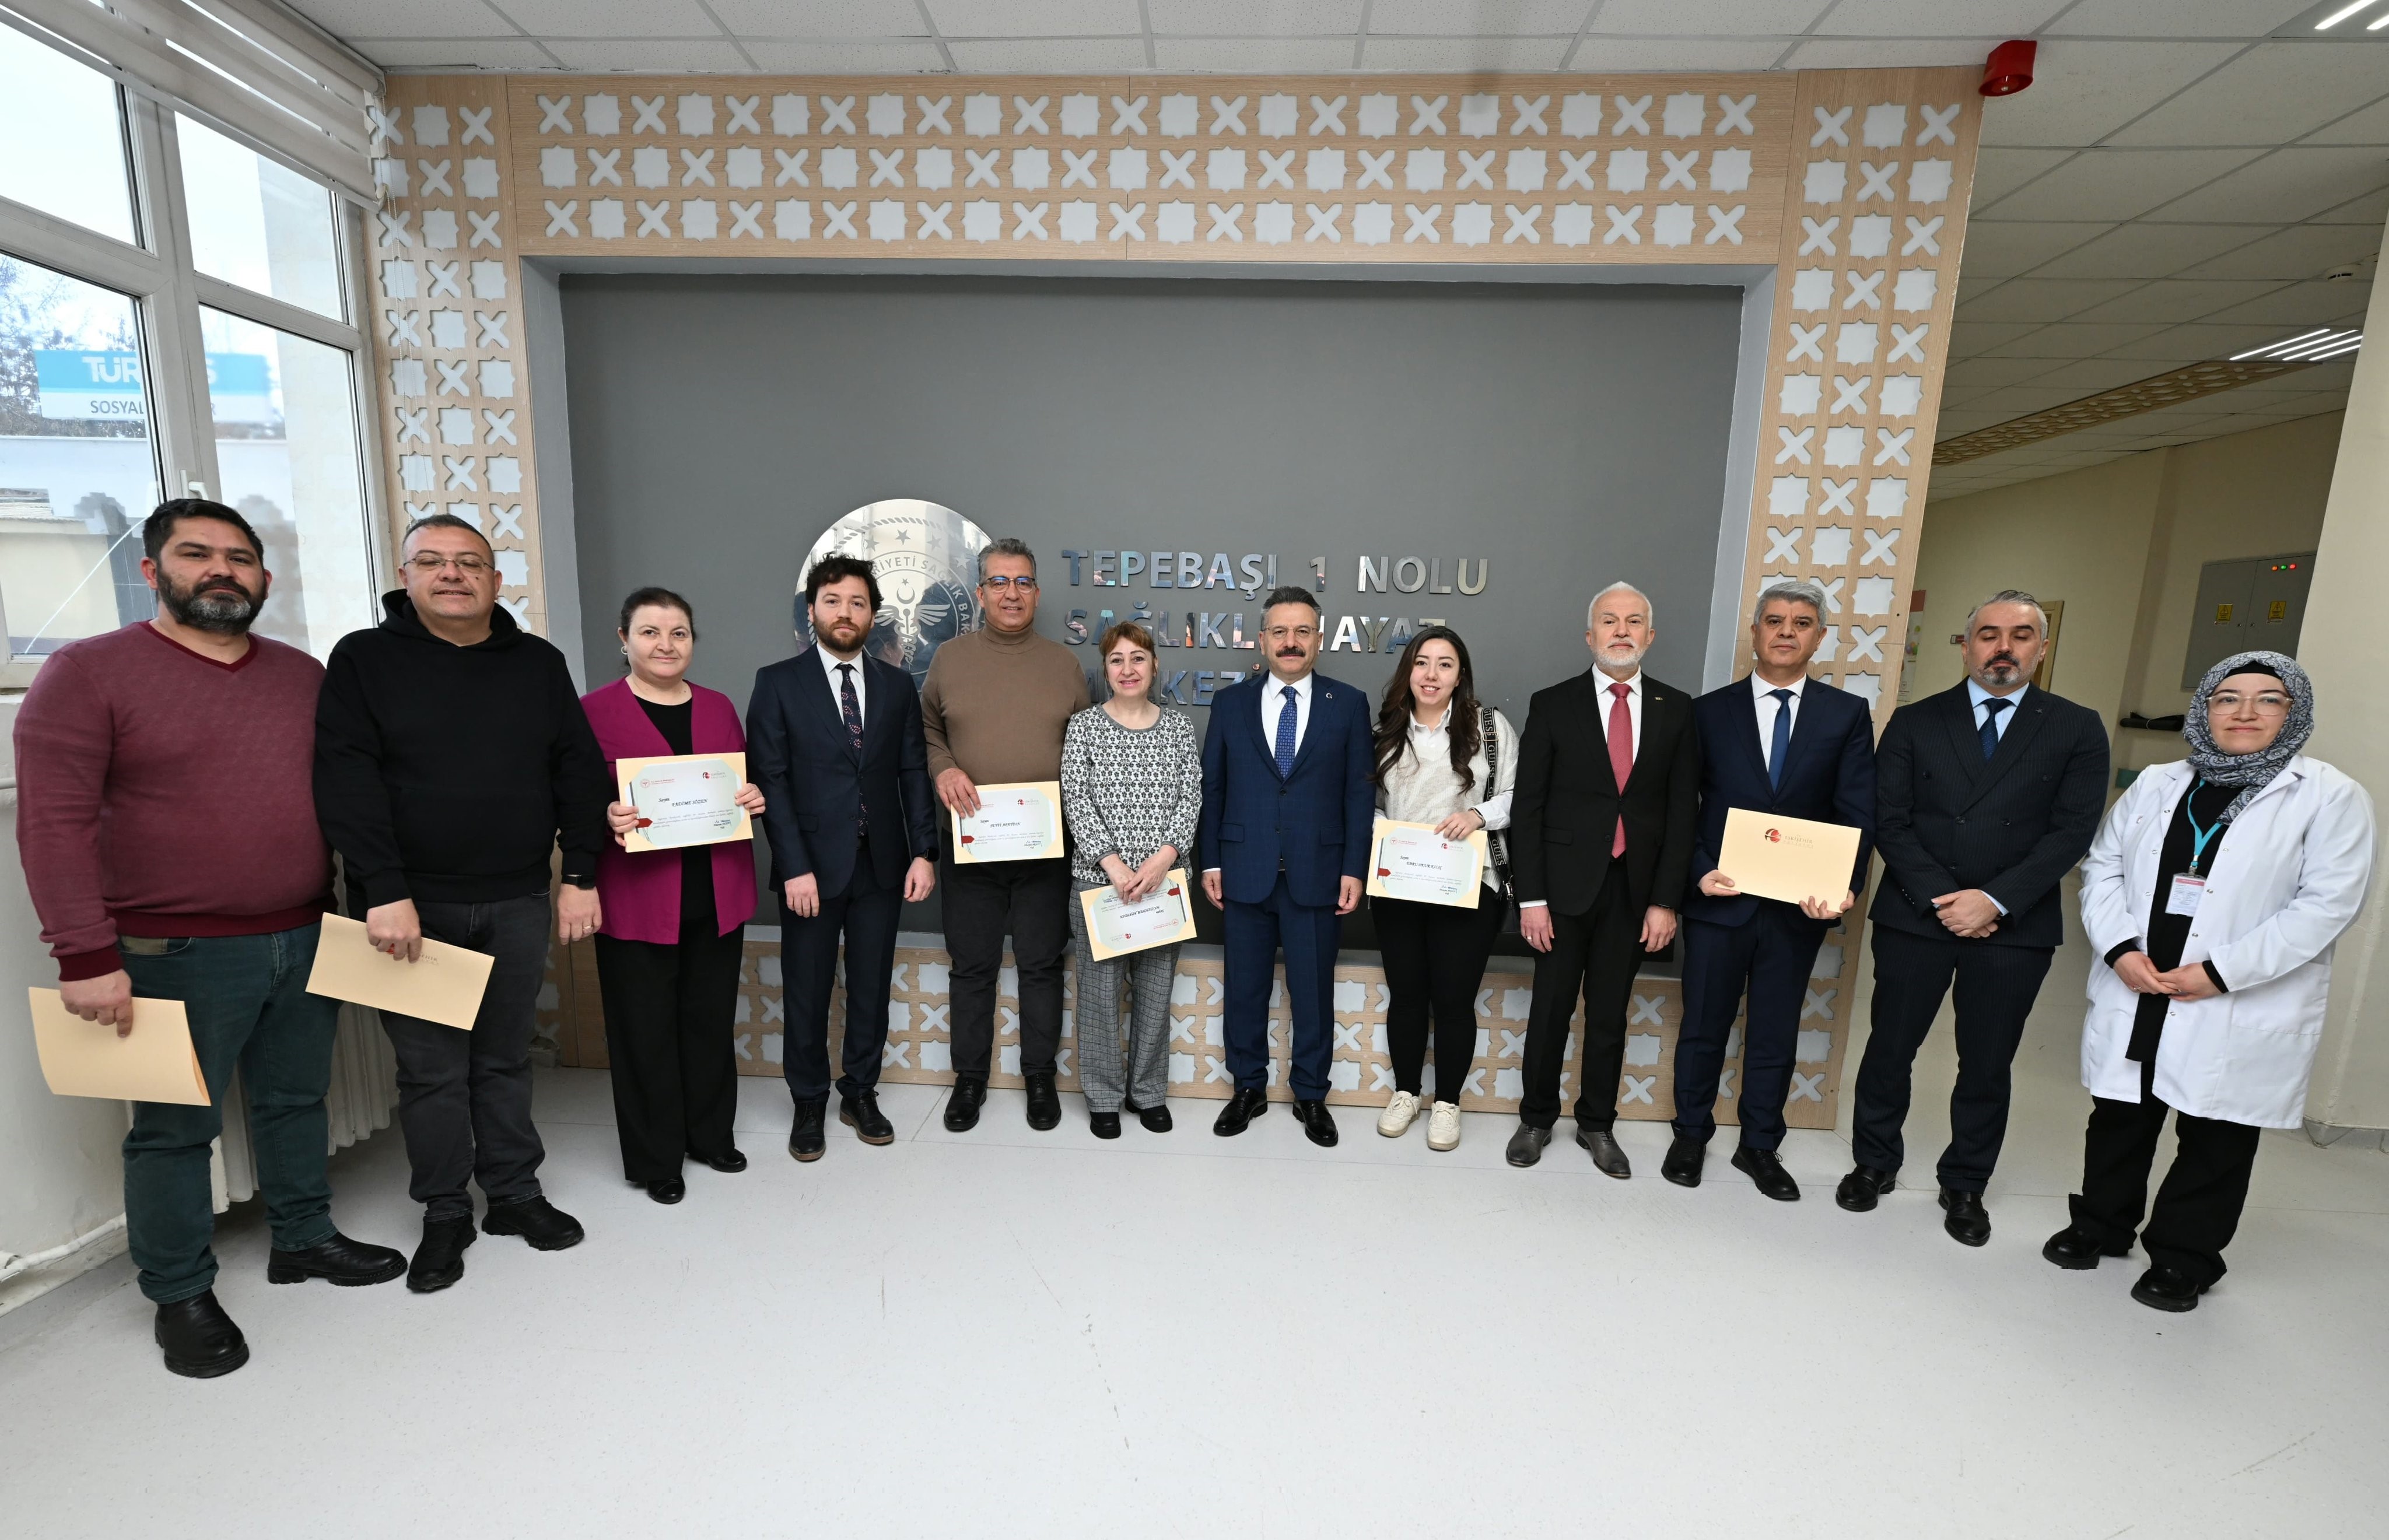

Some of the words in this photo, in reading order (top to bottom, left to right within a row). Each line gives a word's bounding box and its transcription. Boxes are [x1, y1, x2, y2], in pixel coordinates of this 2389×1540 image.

[90, 400, 144, 415] SOSYAL
[1062, 549, 1277, 601] TEPEBAŞI
[1309, 556, 1326, 592] 1
[1357, 555, 1488, 595] NOLU
[1064, 601, 1255, 649] SAĞLIKL
[1318, 615, 1446, 653] AYA
[1491, 839, 1505, 866] GUES
